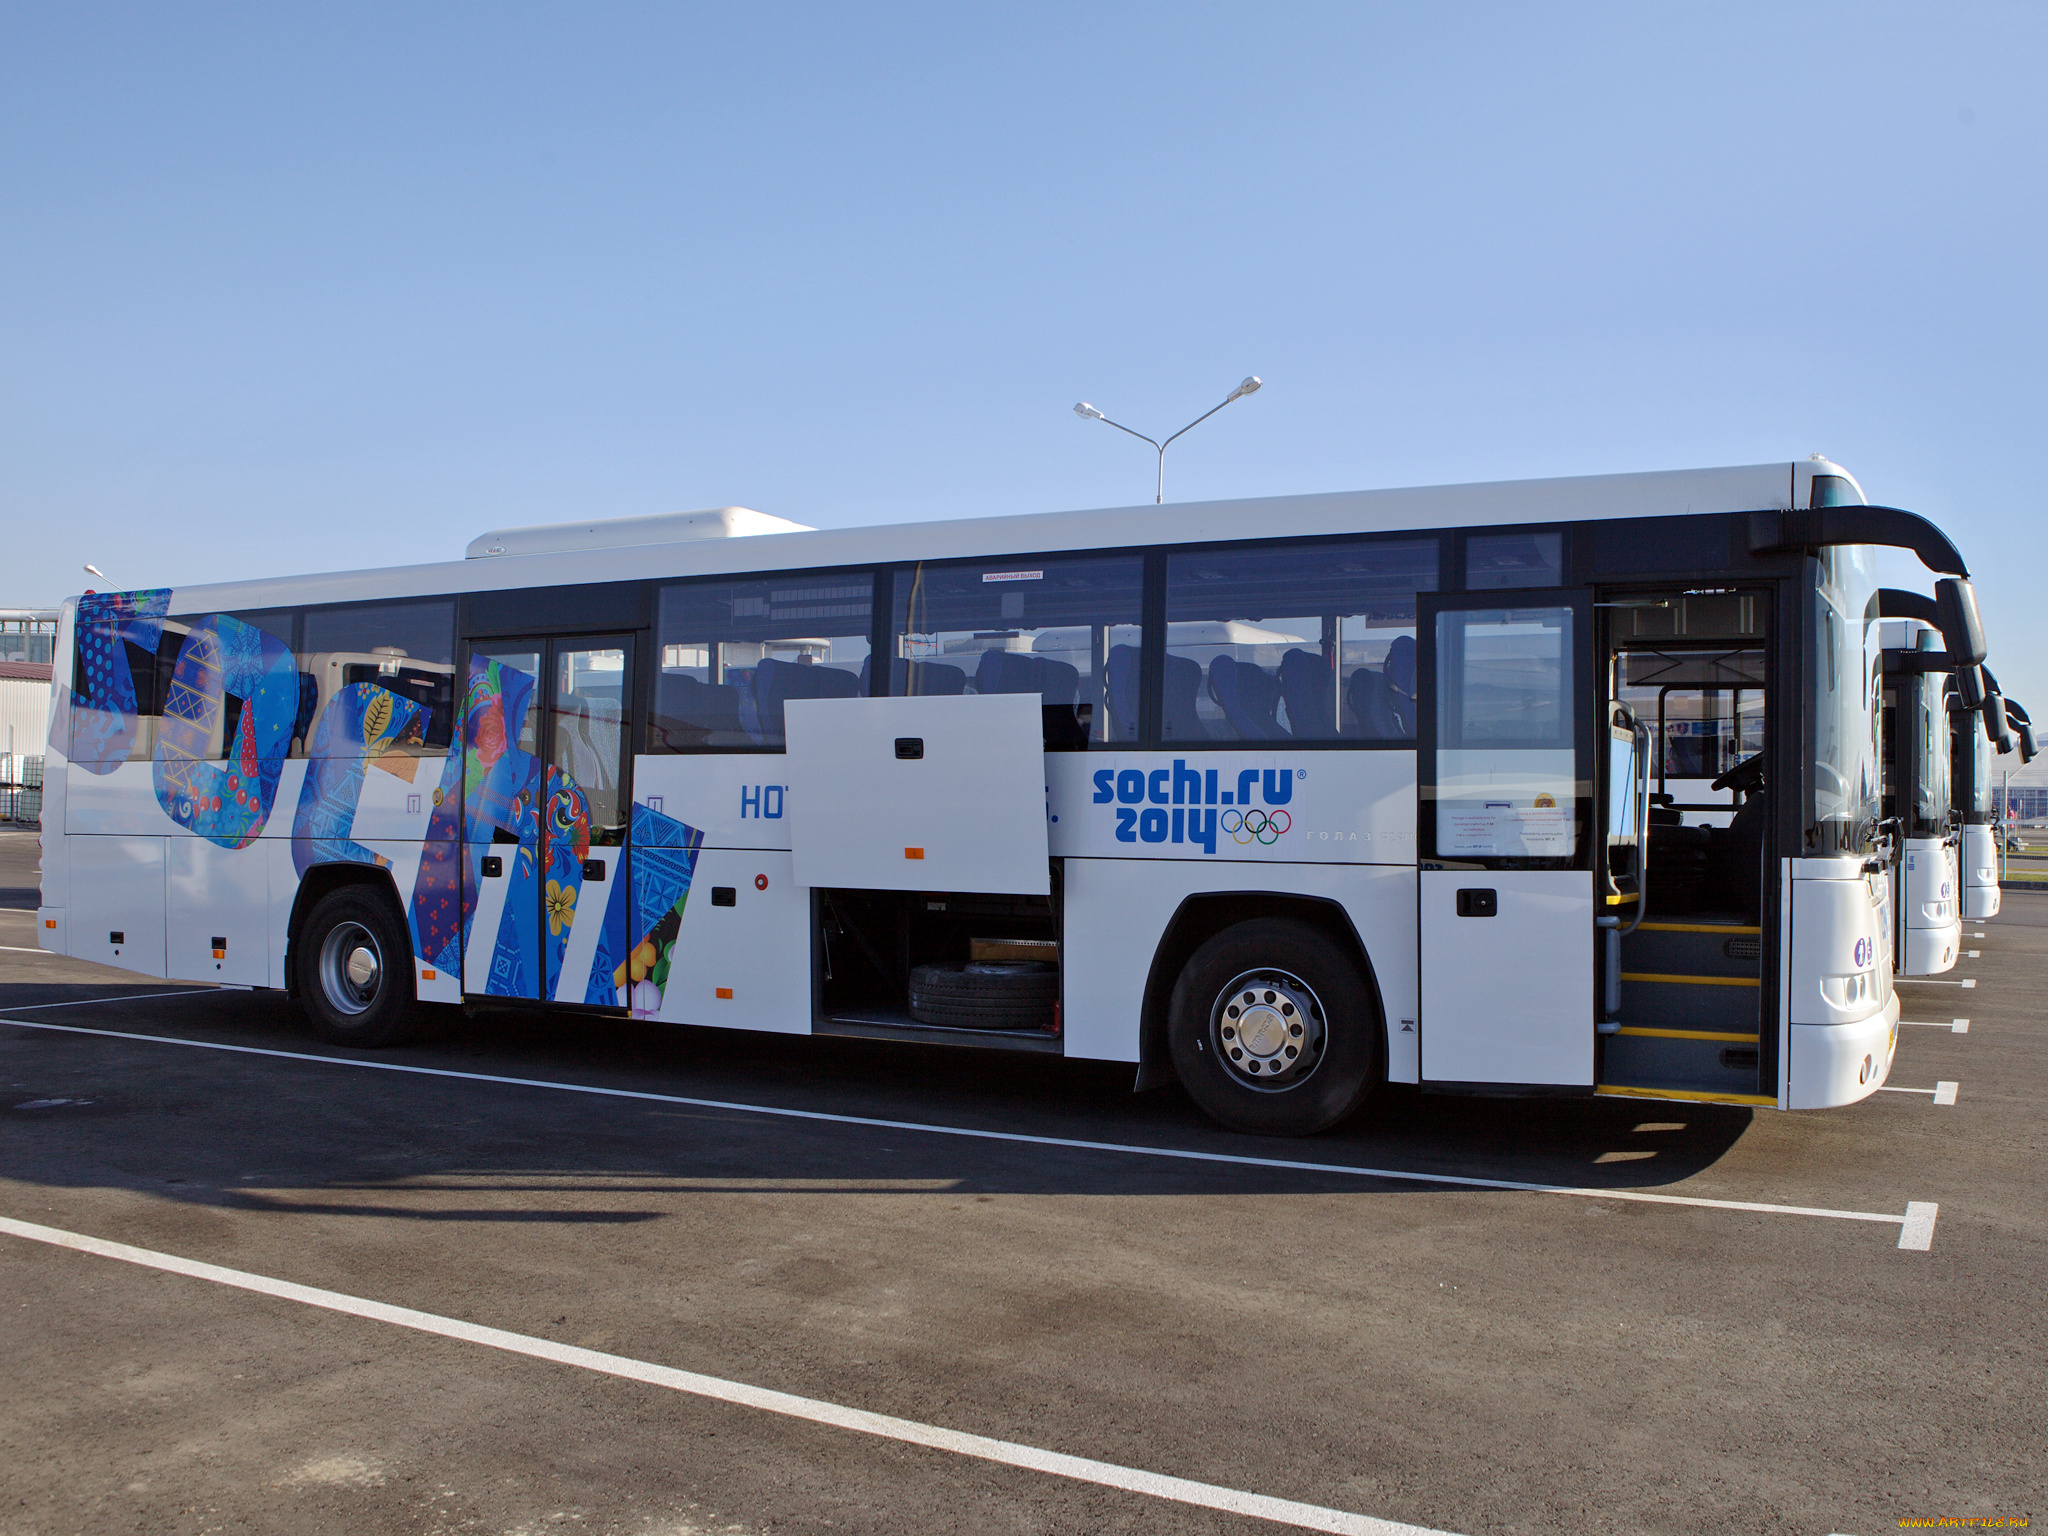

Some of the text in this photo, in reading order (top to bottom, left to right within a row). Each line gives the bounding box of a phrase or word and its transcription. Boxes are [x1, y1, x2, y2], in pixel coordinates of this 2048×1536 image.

[985, 573, 1019, 581] АВАРИЙНЫЙ
[1115, 807, 1217, 854] 2014
[1306, 830, 1371, 841] ГОЛАЗ
